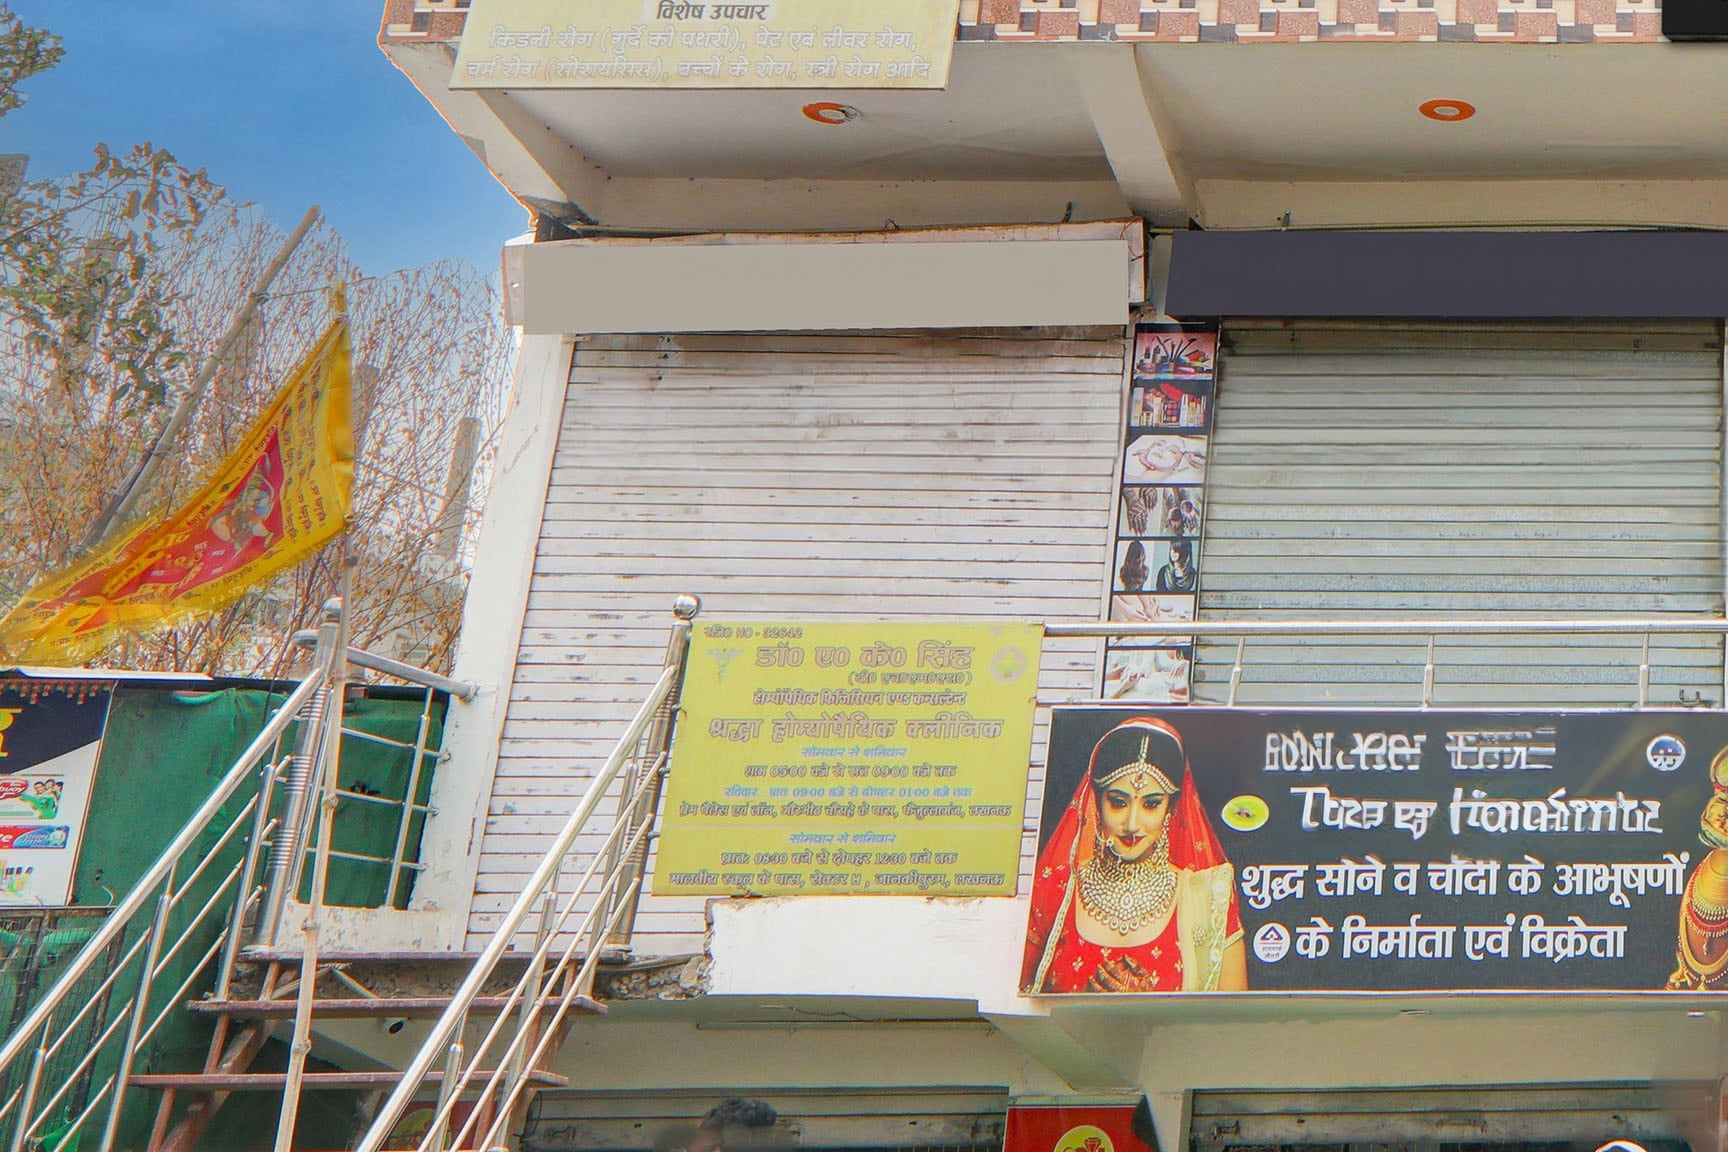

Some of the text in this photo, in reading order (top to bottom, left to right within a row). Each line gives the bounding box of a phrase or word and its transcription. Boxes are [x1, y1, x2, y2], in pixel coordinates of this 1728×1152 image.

[656, 0, 769, 20] विशेष उपचार
[489, 25, 551, 48] किडनी
[557, 25, 595, 48] रोग
[647, 25, 676, 48] की
[755, 25, 784, 48] पेट
[787, 26, 816, 50] एवं
[822, 25, 870, 48] लीवर
[875, 26, 917, 51] रोग,
[465, 56, 499, 78] चर्म
[501, 56, 540, 78] रोग
[728, 56, 749, 78] के
[844, 56, 880, 78] रोग
[885, 56, 930, 79] आदि
[917, 640, 975, 669] सिंह
[708, 711, 1004, 743] श्रद्धा होम्योपैथिक क्लीनिक
[1240, 851, 1690, 910] शुद्ध सोने व के आभूषणों
[1295, 913, 1627, 964] के निर्माता एवं विक्रेता
